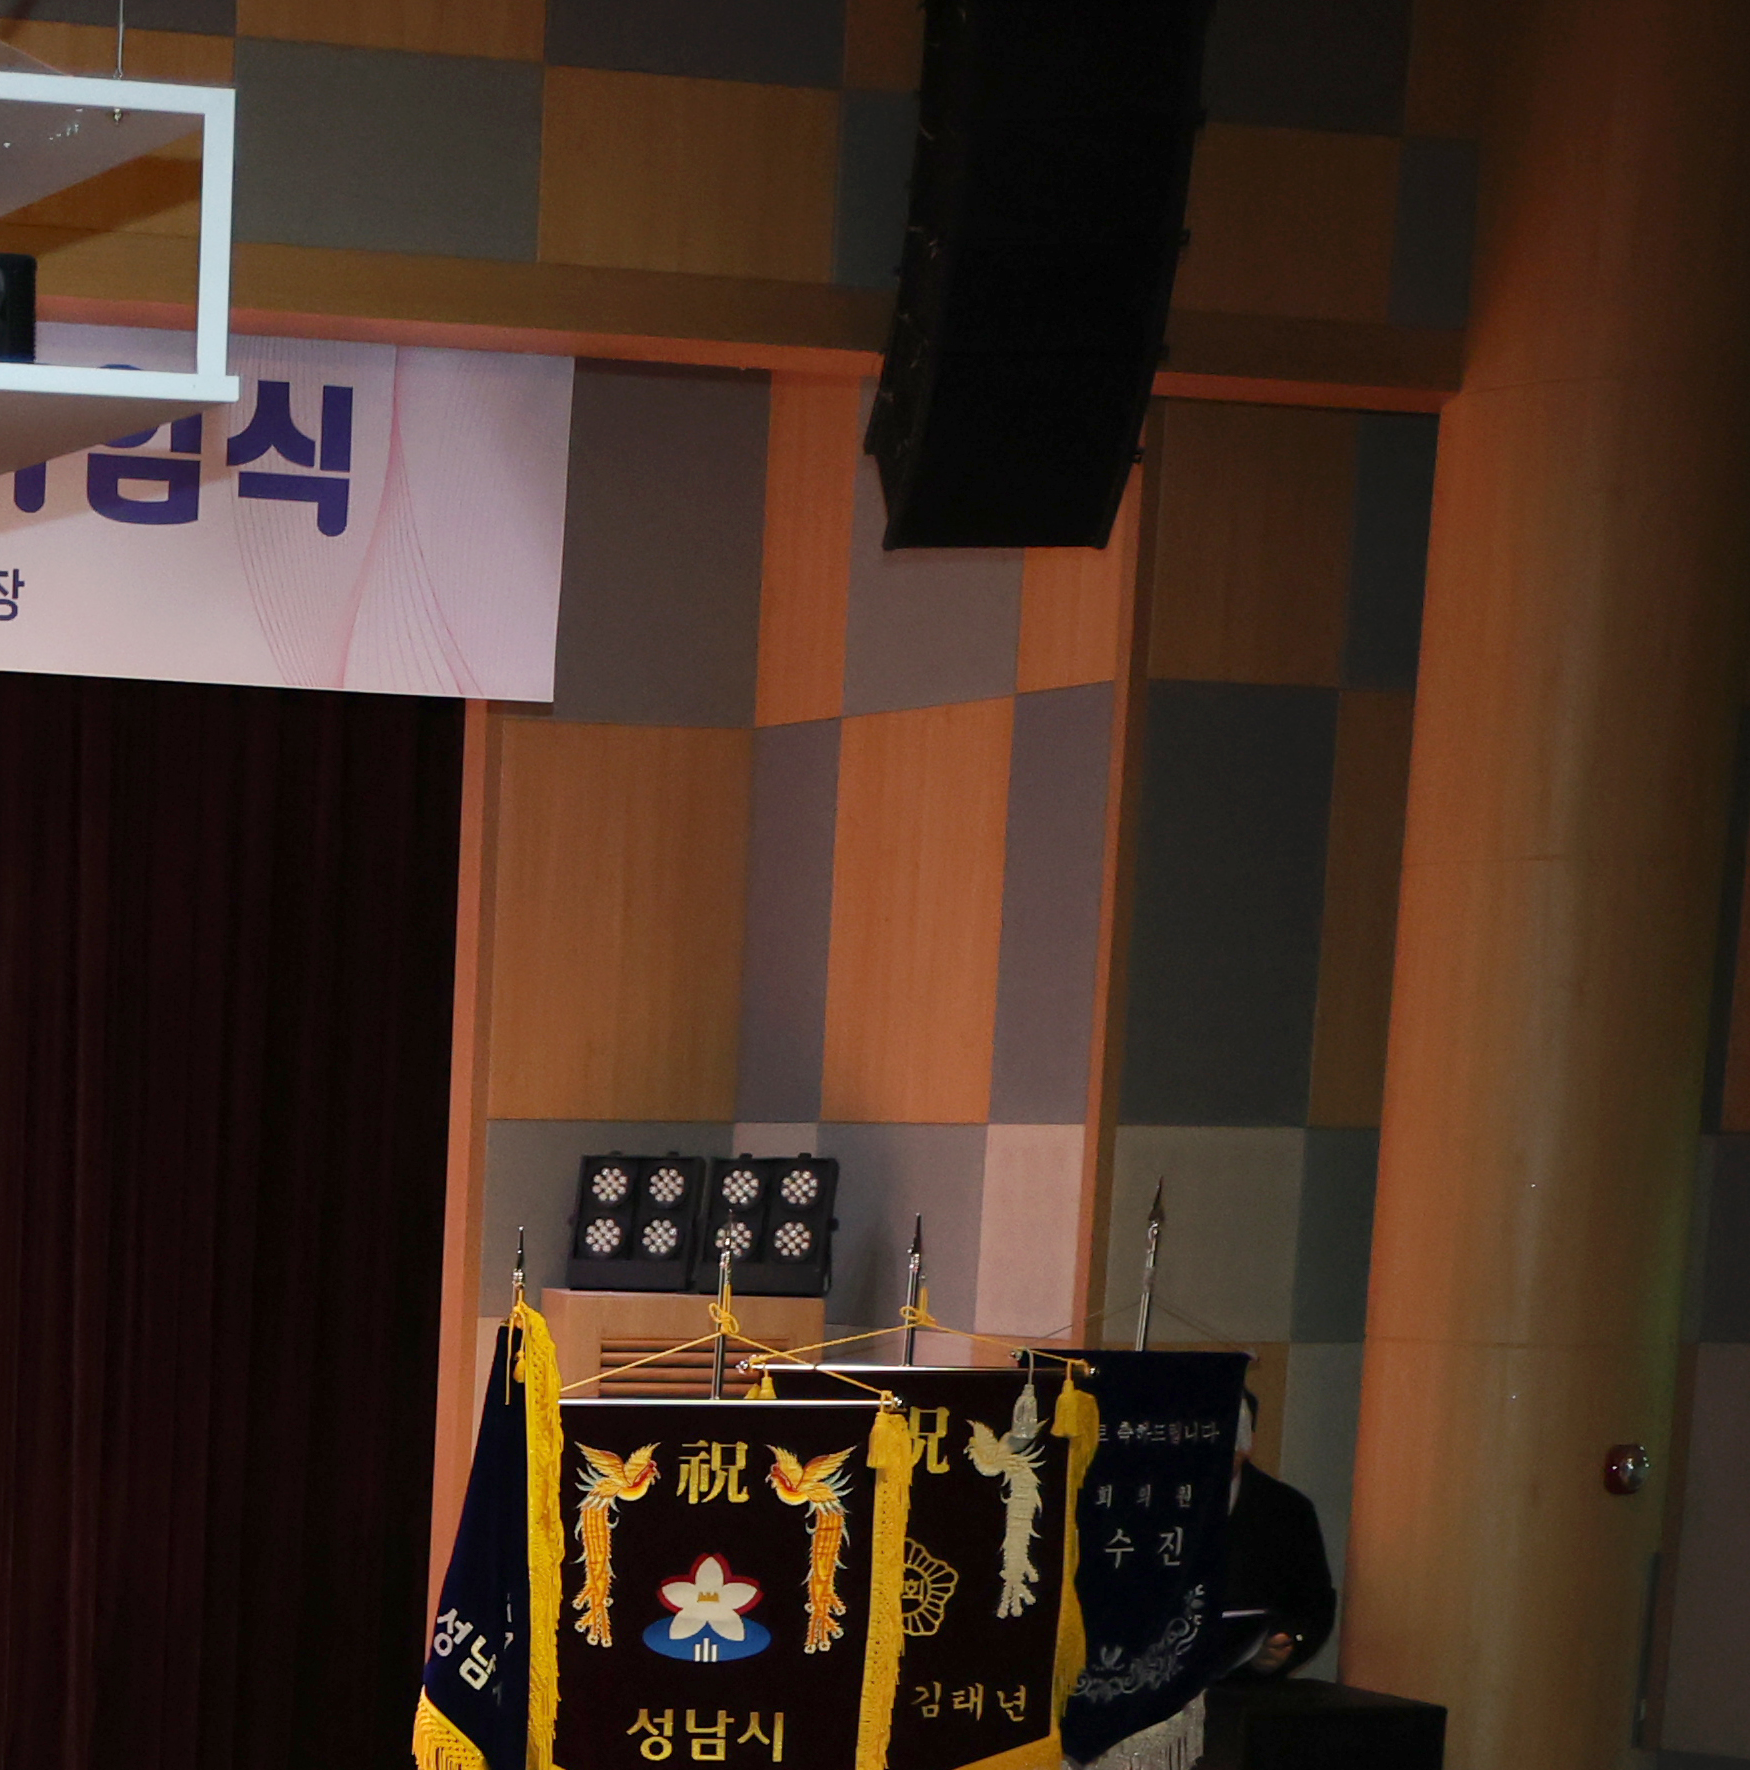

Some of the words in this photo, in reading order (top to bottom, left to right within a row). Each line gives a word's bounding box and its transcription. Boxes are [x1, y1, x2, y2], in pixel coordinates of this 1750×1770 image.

[676, 1439, 751, 1505] 祝
[902, 1577, 925, 1601] 회
[625, 1707, 785, 1763] 성남시
